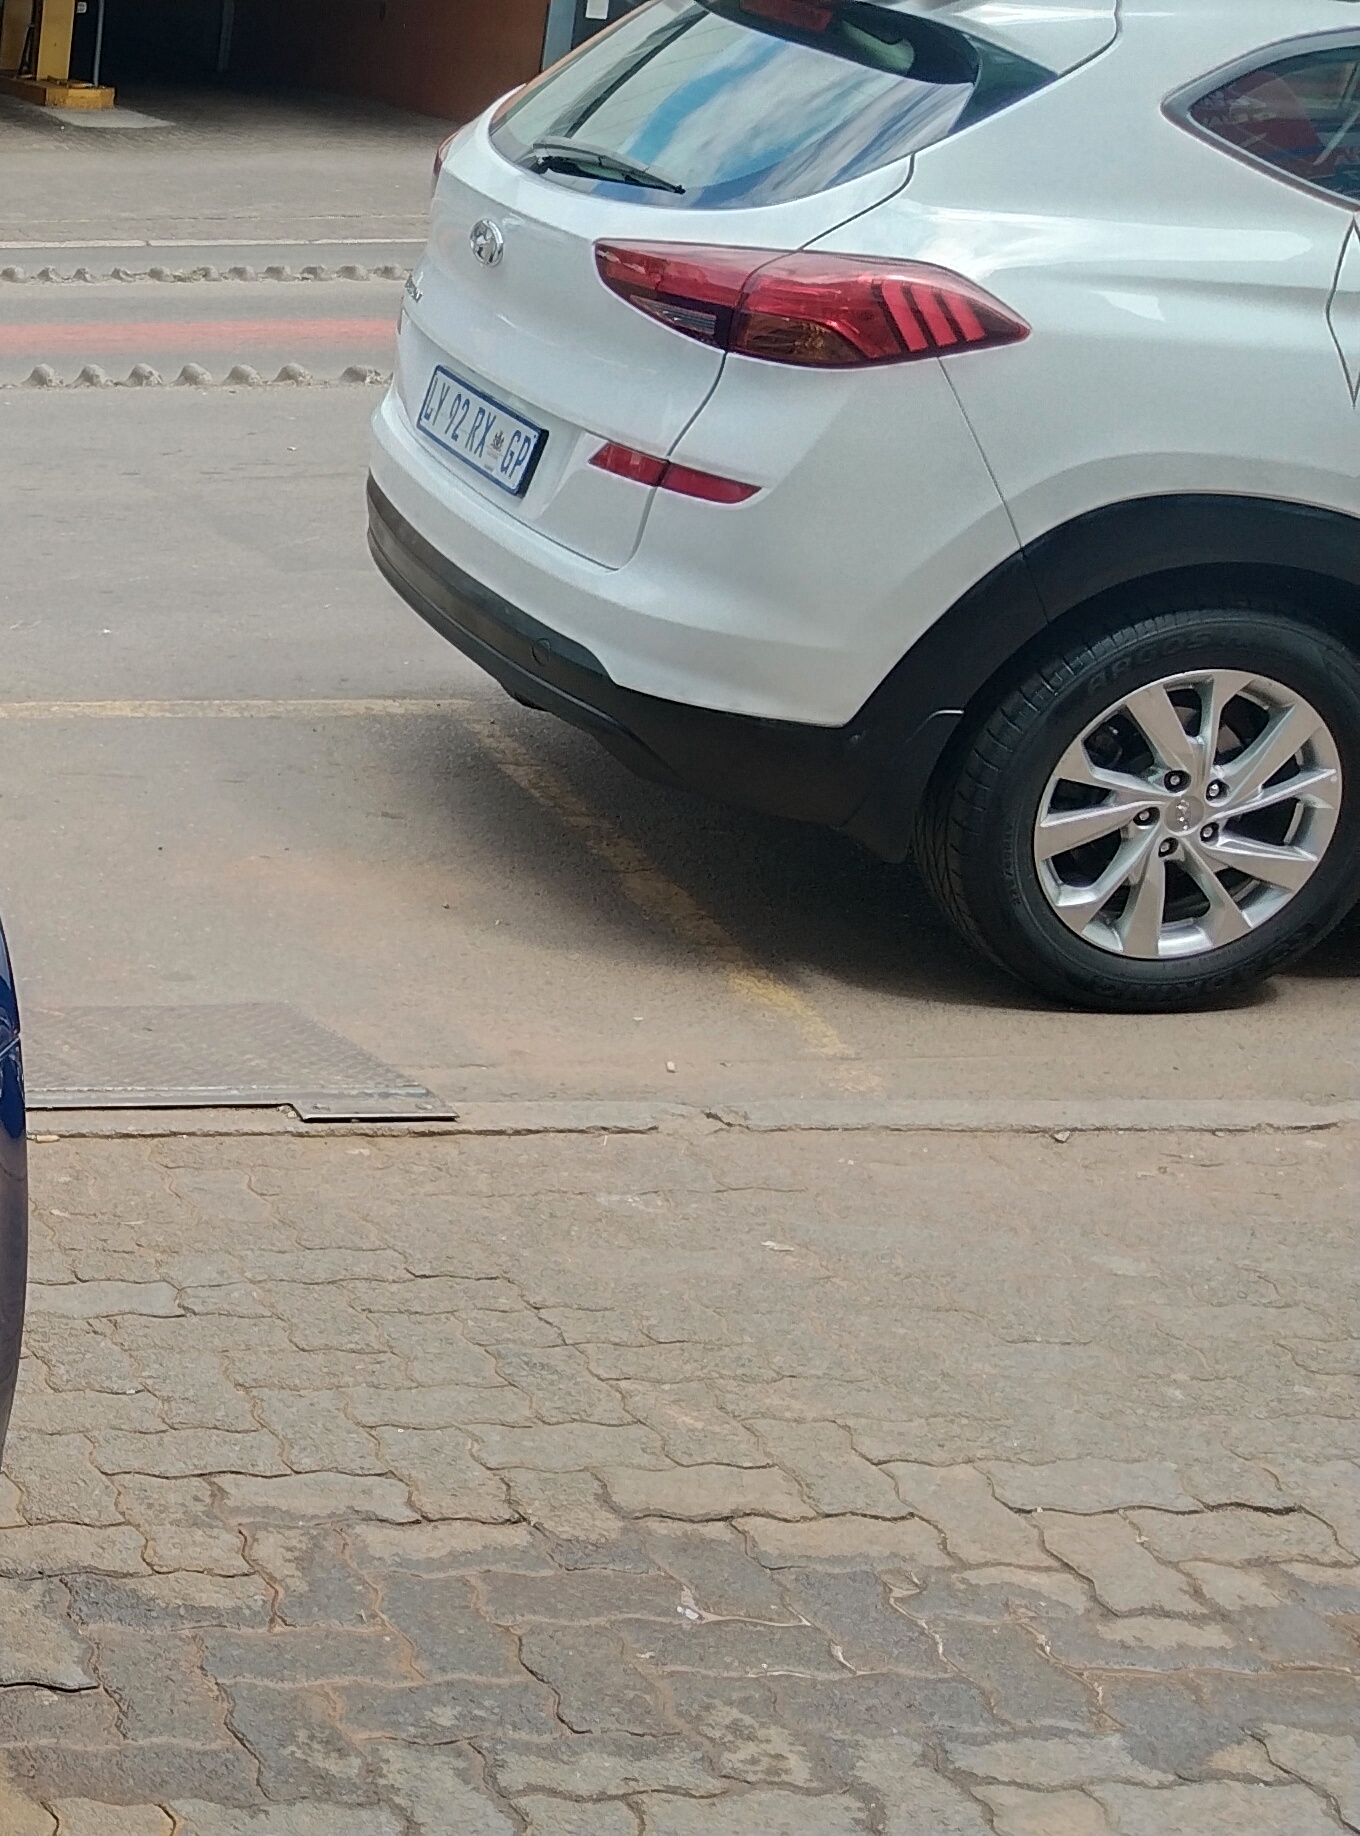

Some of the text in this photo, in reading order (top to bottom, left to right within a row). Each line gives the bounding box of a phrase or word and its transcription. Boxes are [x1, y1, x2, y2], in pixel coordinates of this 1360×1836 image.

[424, 378, 450, 426] LY
[445, 392, 470, 441] 92
[465, 407, 497, 458] RX
[500, 430, 531, 479] GP
